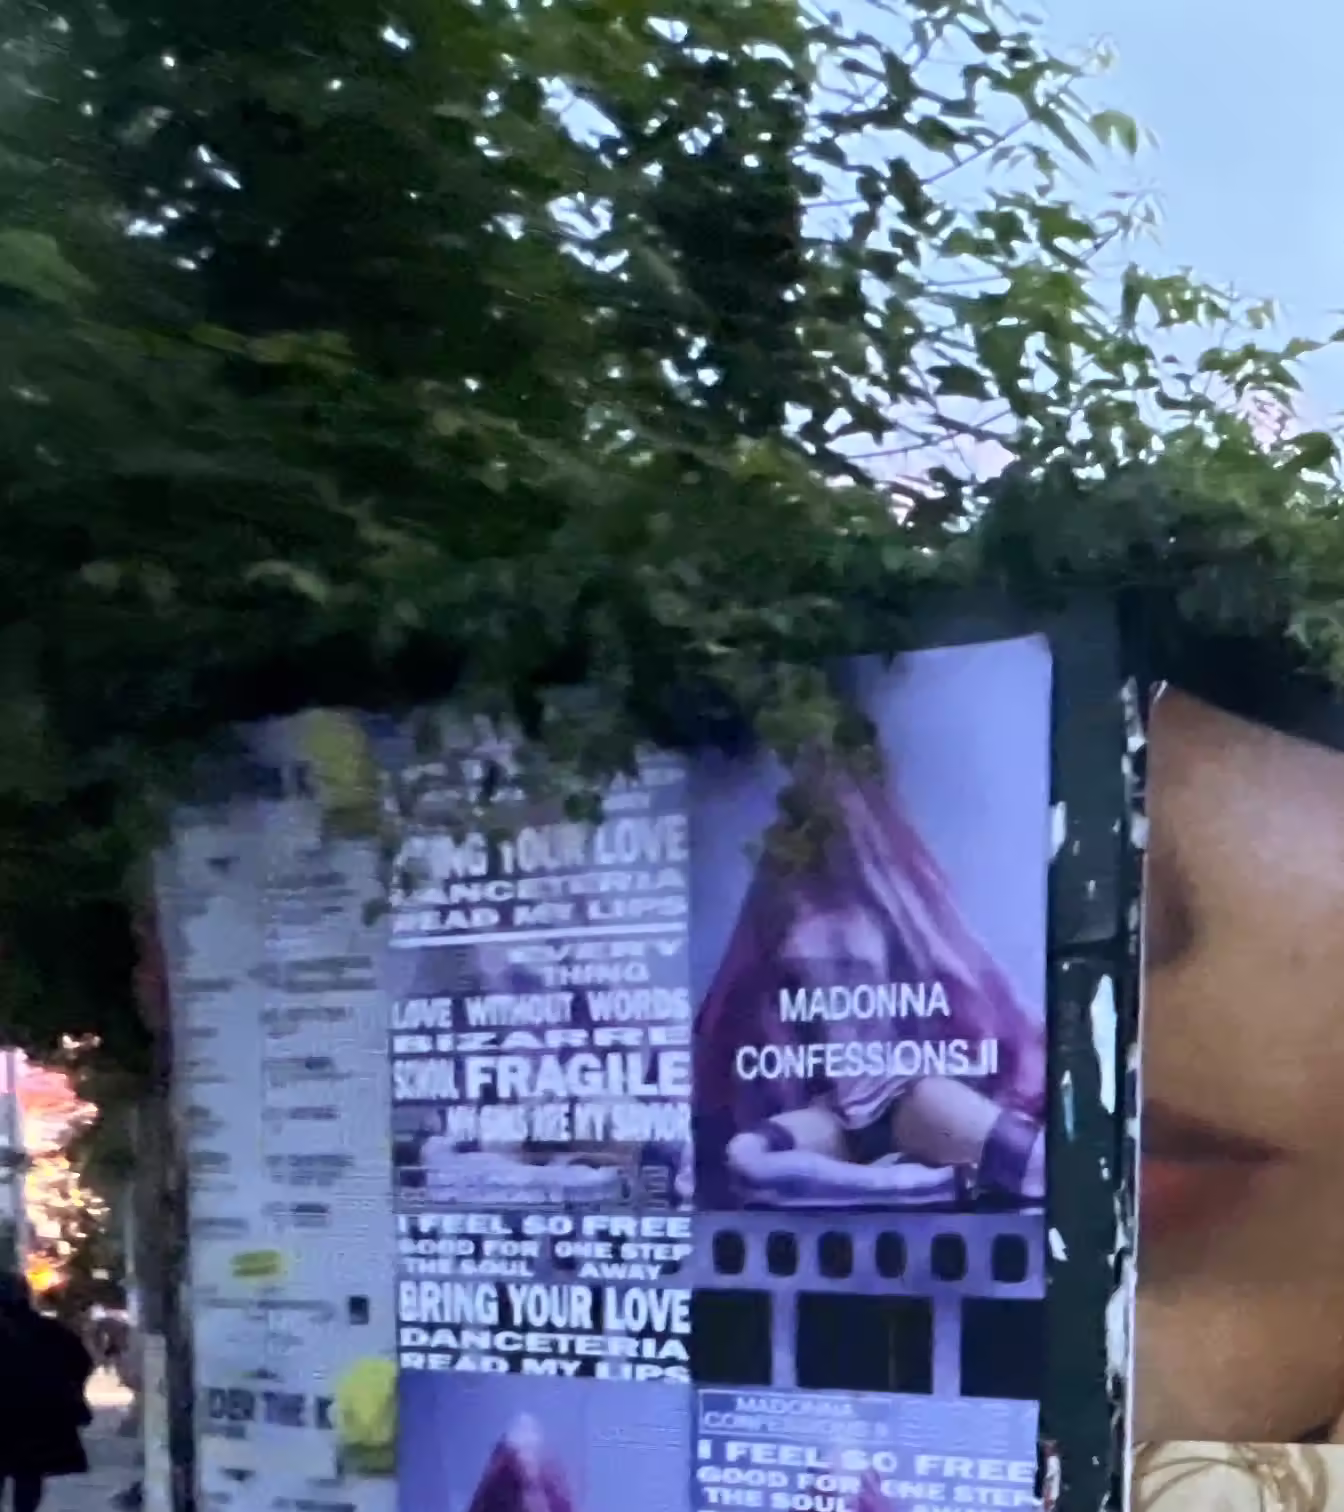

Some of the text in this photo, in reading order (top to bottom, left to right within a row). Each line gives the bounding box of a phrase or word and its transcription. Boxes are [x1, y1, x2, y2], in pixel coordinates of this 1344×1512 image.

[594, 814, 689, 865] LOVE
[585, 987, 691, 1021] WORDS
[779, 981, 950, 1022] MADONNA
[464, 1051, 692, 1099] FRAGILE
[735, 1039, 969, 1080] CONFESSIONS
[417, 1214, 513, 1234] FEEL
[521, 1215, 573, 1235] SO
[582, 1215, 692, 1238] FREE
[482, 1240, 539, 1257] FOR
[554, 1241, 692, 1260] ONE STEP
[404, 1257, 534, 1277] THE SOUL
[577, 1263, 663, 1280] AWAY
[399, 1281, 692, 1334] BRING YOUR LOVE
[399, 1327, 690, 1361] DANCETERIA
[400, 1353, 691, 1384] READ MY LIPS
[698, 1440, 1037, 1483] I FEEL SO FREE
[697, 1466, 861, 1494] GOOD FOR
[880, 1479, 946, 1501] ONE
[703, 1486, 763, 1508] THE
